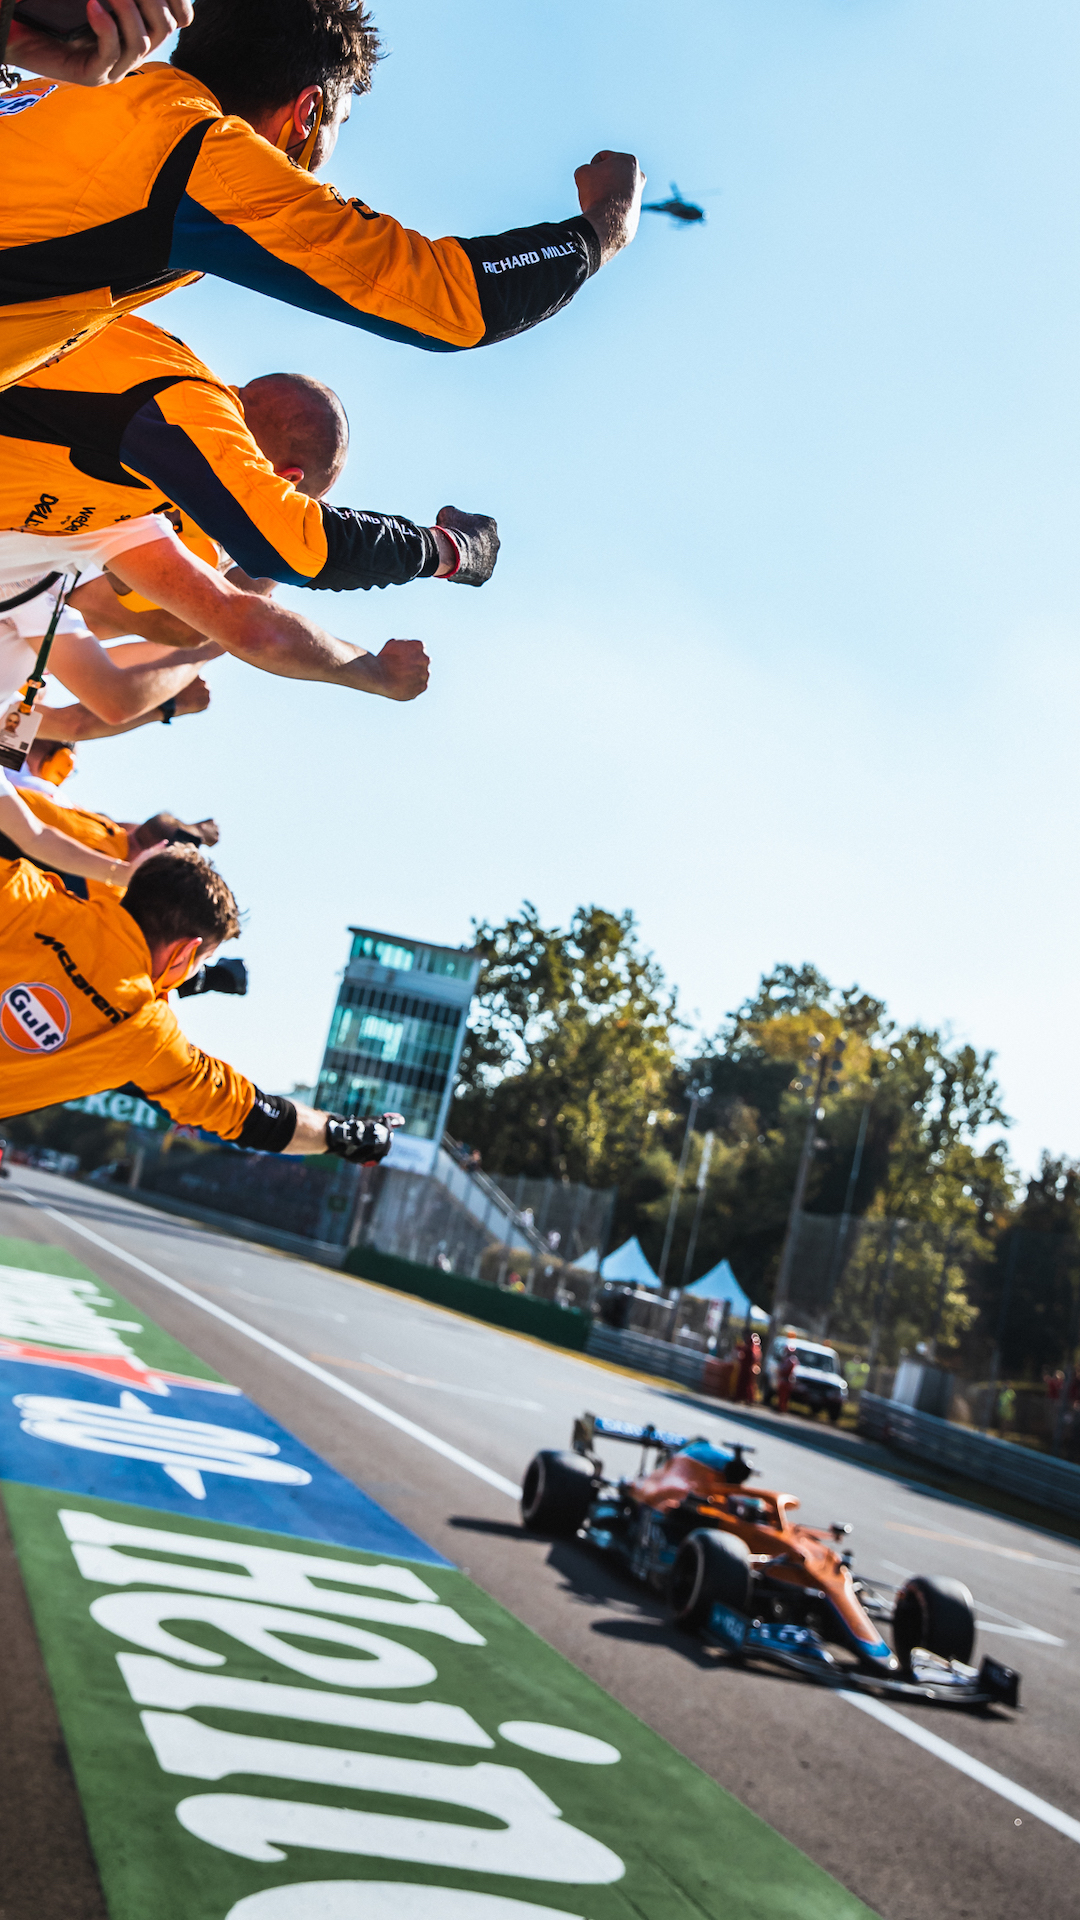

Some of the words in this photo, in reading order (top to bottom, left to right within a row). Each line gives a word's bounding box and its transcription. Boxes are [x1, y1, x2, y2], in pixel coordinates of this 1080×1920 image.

[482, 251, 540, 274] RCHARD
[541, 241, 576, 260] MILLE
[63, 507, 96, 532] webe
[34, 931, 121, 1024] McLaren
[9, 988, 60, 1047] Gulf
[58, 1508, 626, 1920] Hein
